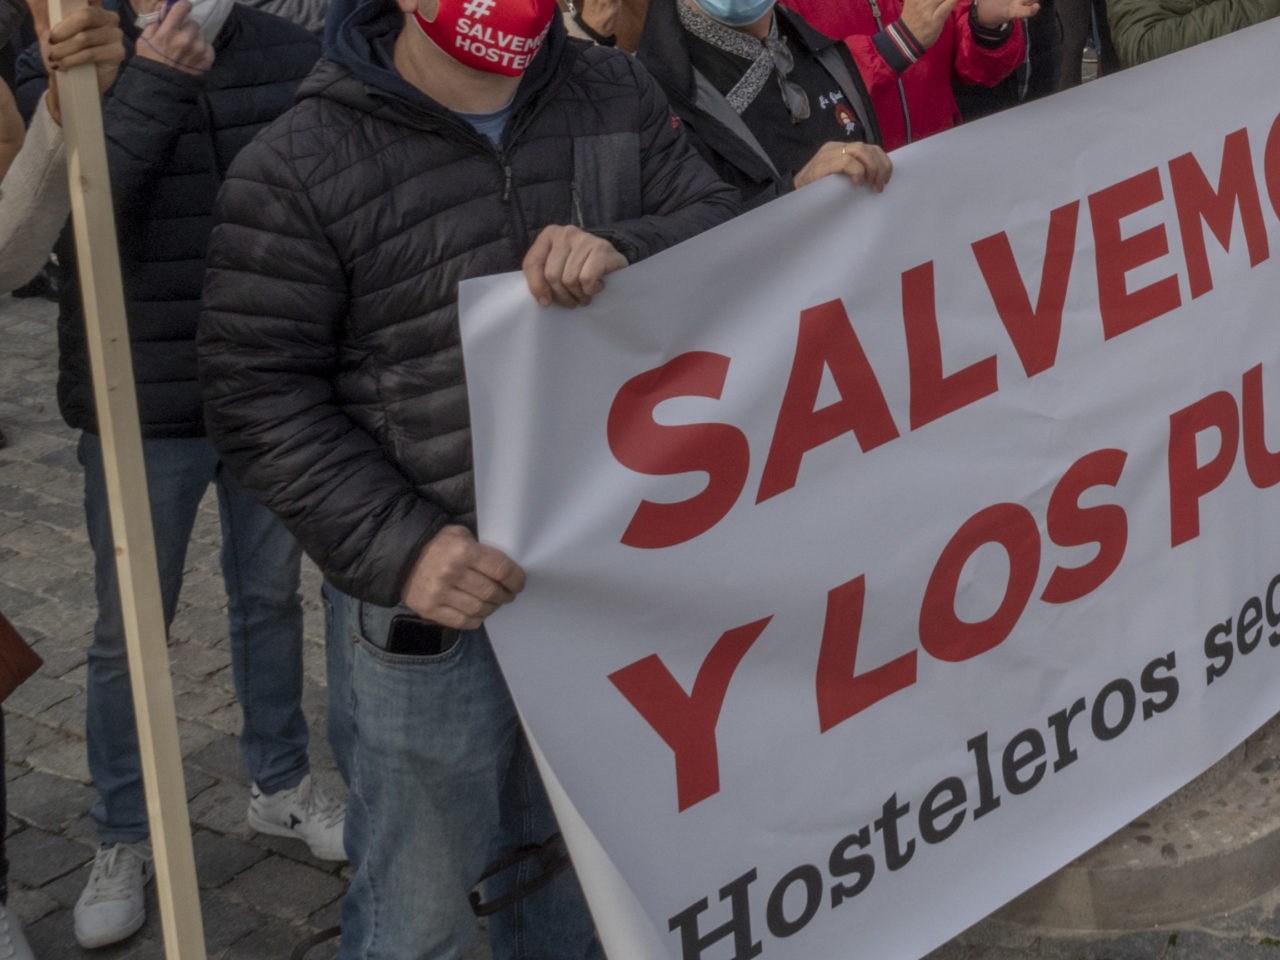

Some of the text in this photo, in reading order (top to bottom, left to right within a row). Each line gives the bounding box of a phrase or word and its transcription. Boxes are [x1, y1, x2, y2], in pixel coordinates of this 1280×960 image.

[606, 614, 775, 813] Y
[815, 447, 1129, 735] LOS
[667, 650, 1181, 960] Hosteleros
